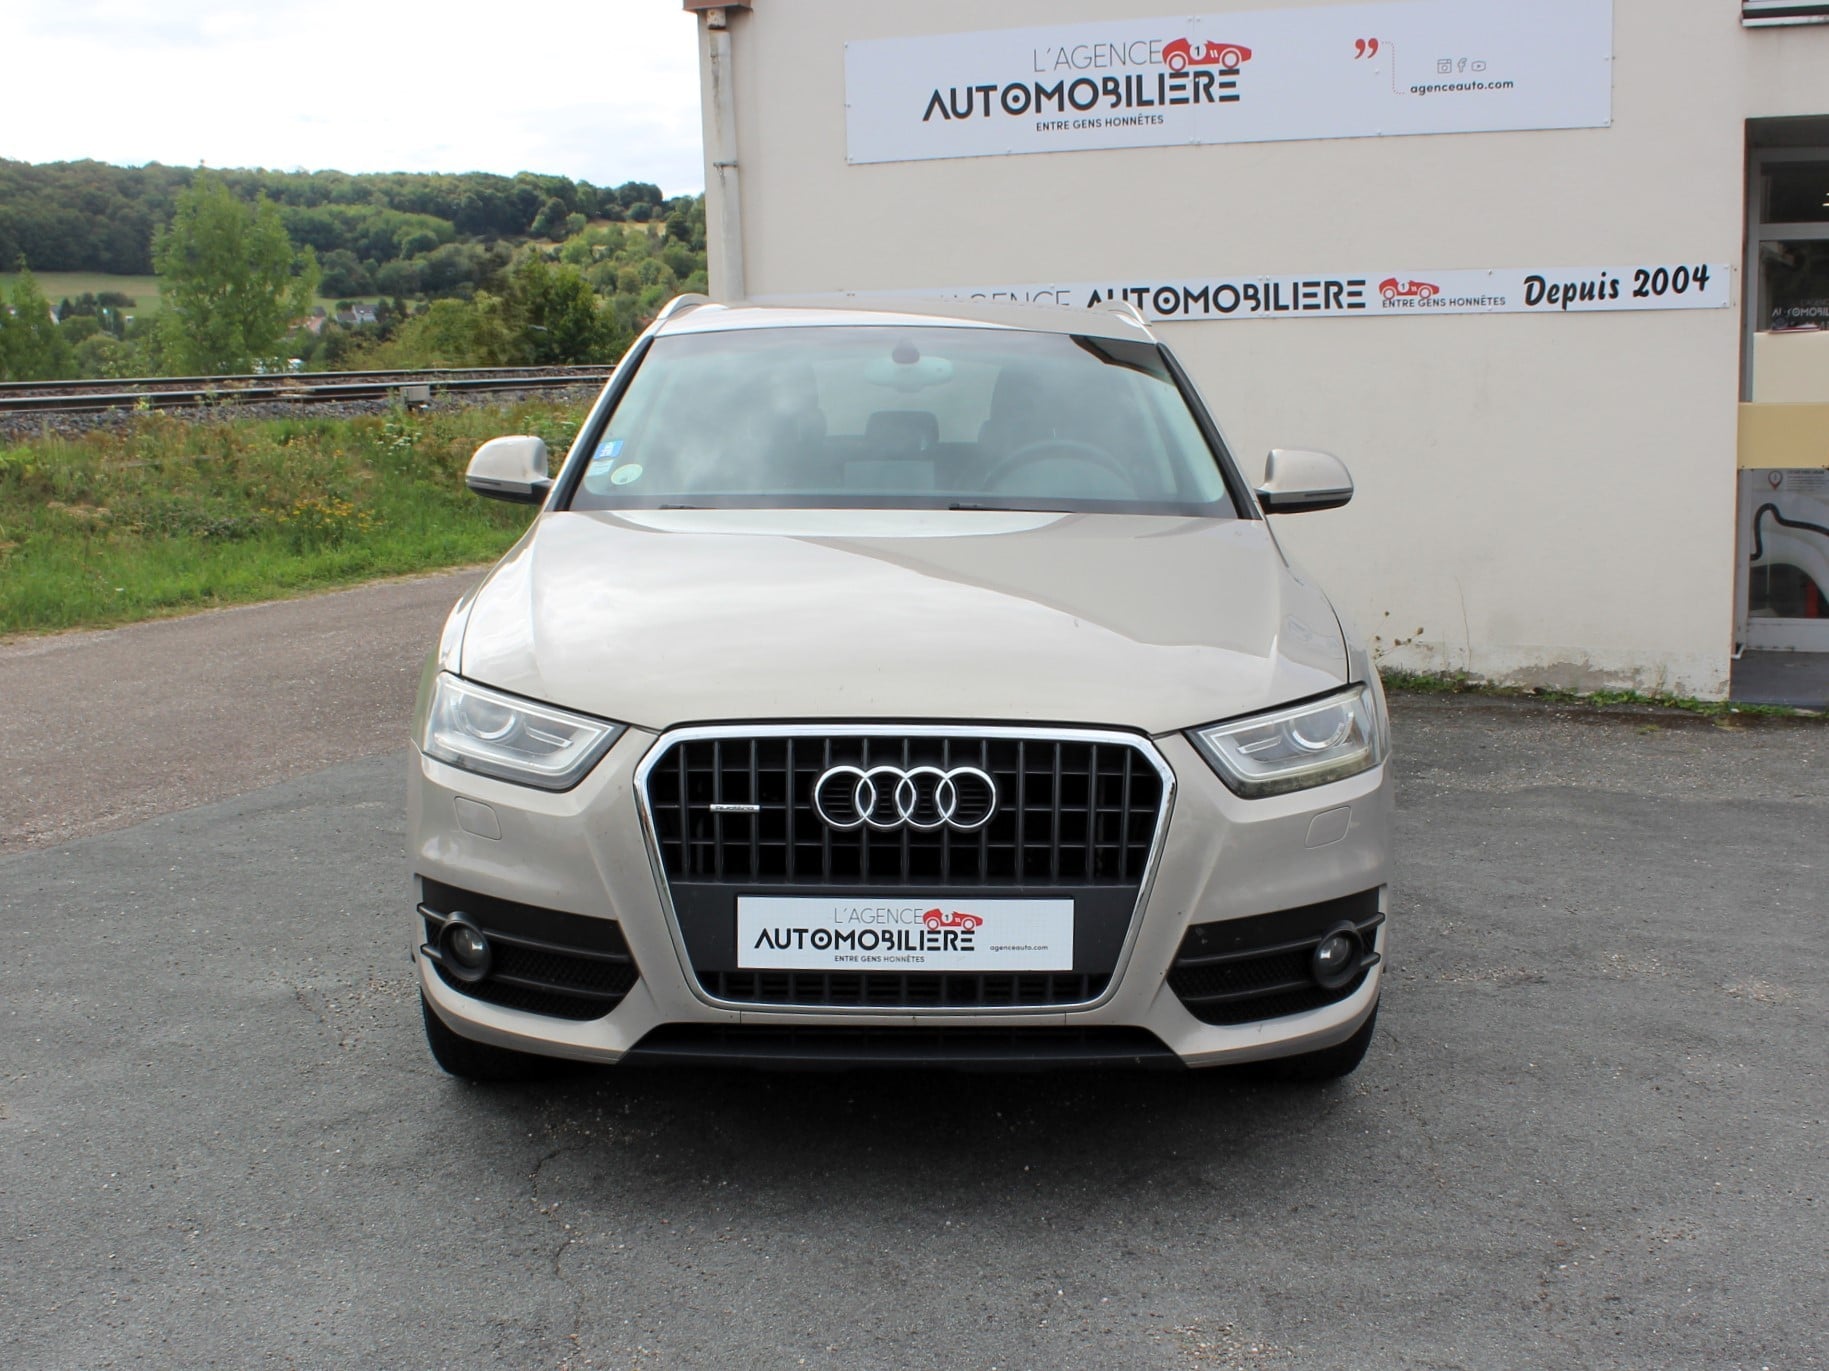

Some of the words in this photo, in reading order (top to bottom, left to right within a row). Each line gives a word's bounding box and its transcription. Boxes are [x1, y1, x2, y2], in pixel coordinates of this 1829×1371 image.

[1033, 39, 1163, 73] L'AGENCE
[922, 68, 1241, 122] AUTOMOBILIERE
[1410, 80, 1514, 95] agenceauto.com
[1036, 120, 1070, 132] ENTRE
[1073, 118, 1103, 130] GENS
[1105, 113, 1165, 127] HONNÊTES
[1523, 272, 1620, 312] Depuis
[1633, 263, 1711, 299] 2004
[1382, 298, 1415, 309] ENTRE
[1417, 297, 1447, 308] GENS
[1449, 294, 1506, 307] HONNÊTES
[834, 907, 924, 925] L'AGENCE
[754, 927, 976, 952] AUTOMOBILIERE
[989, 943, 1049, 954] agenceauto.com
[834, 955, 860, 963] ENTRE
[861, 955, 882, 963] GENS
[883, 953, 926, 964] HONNÊTES
